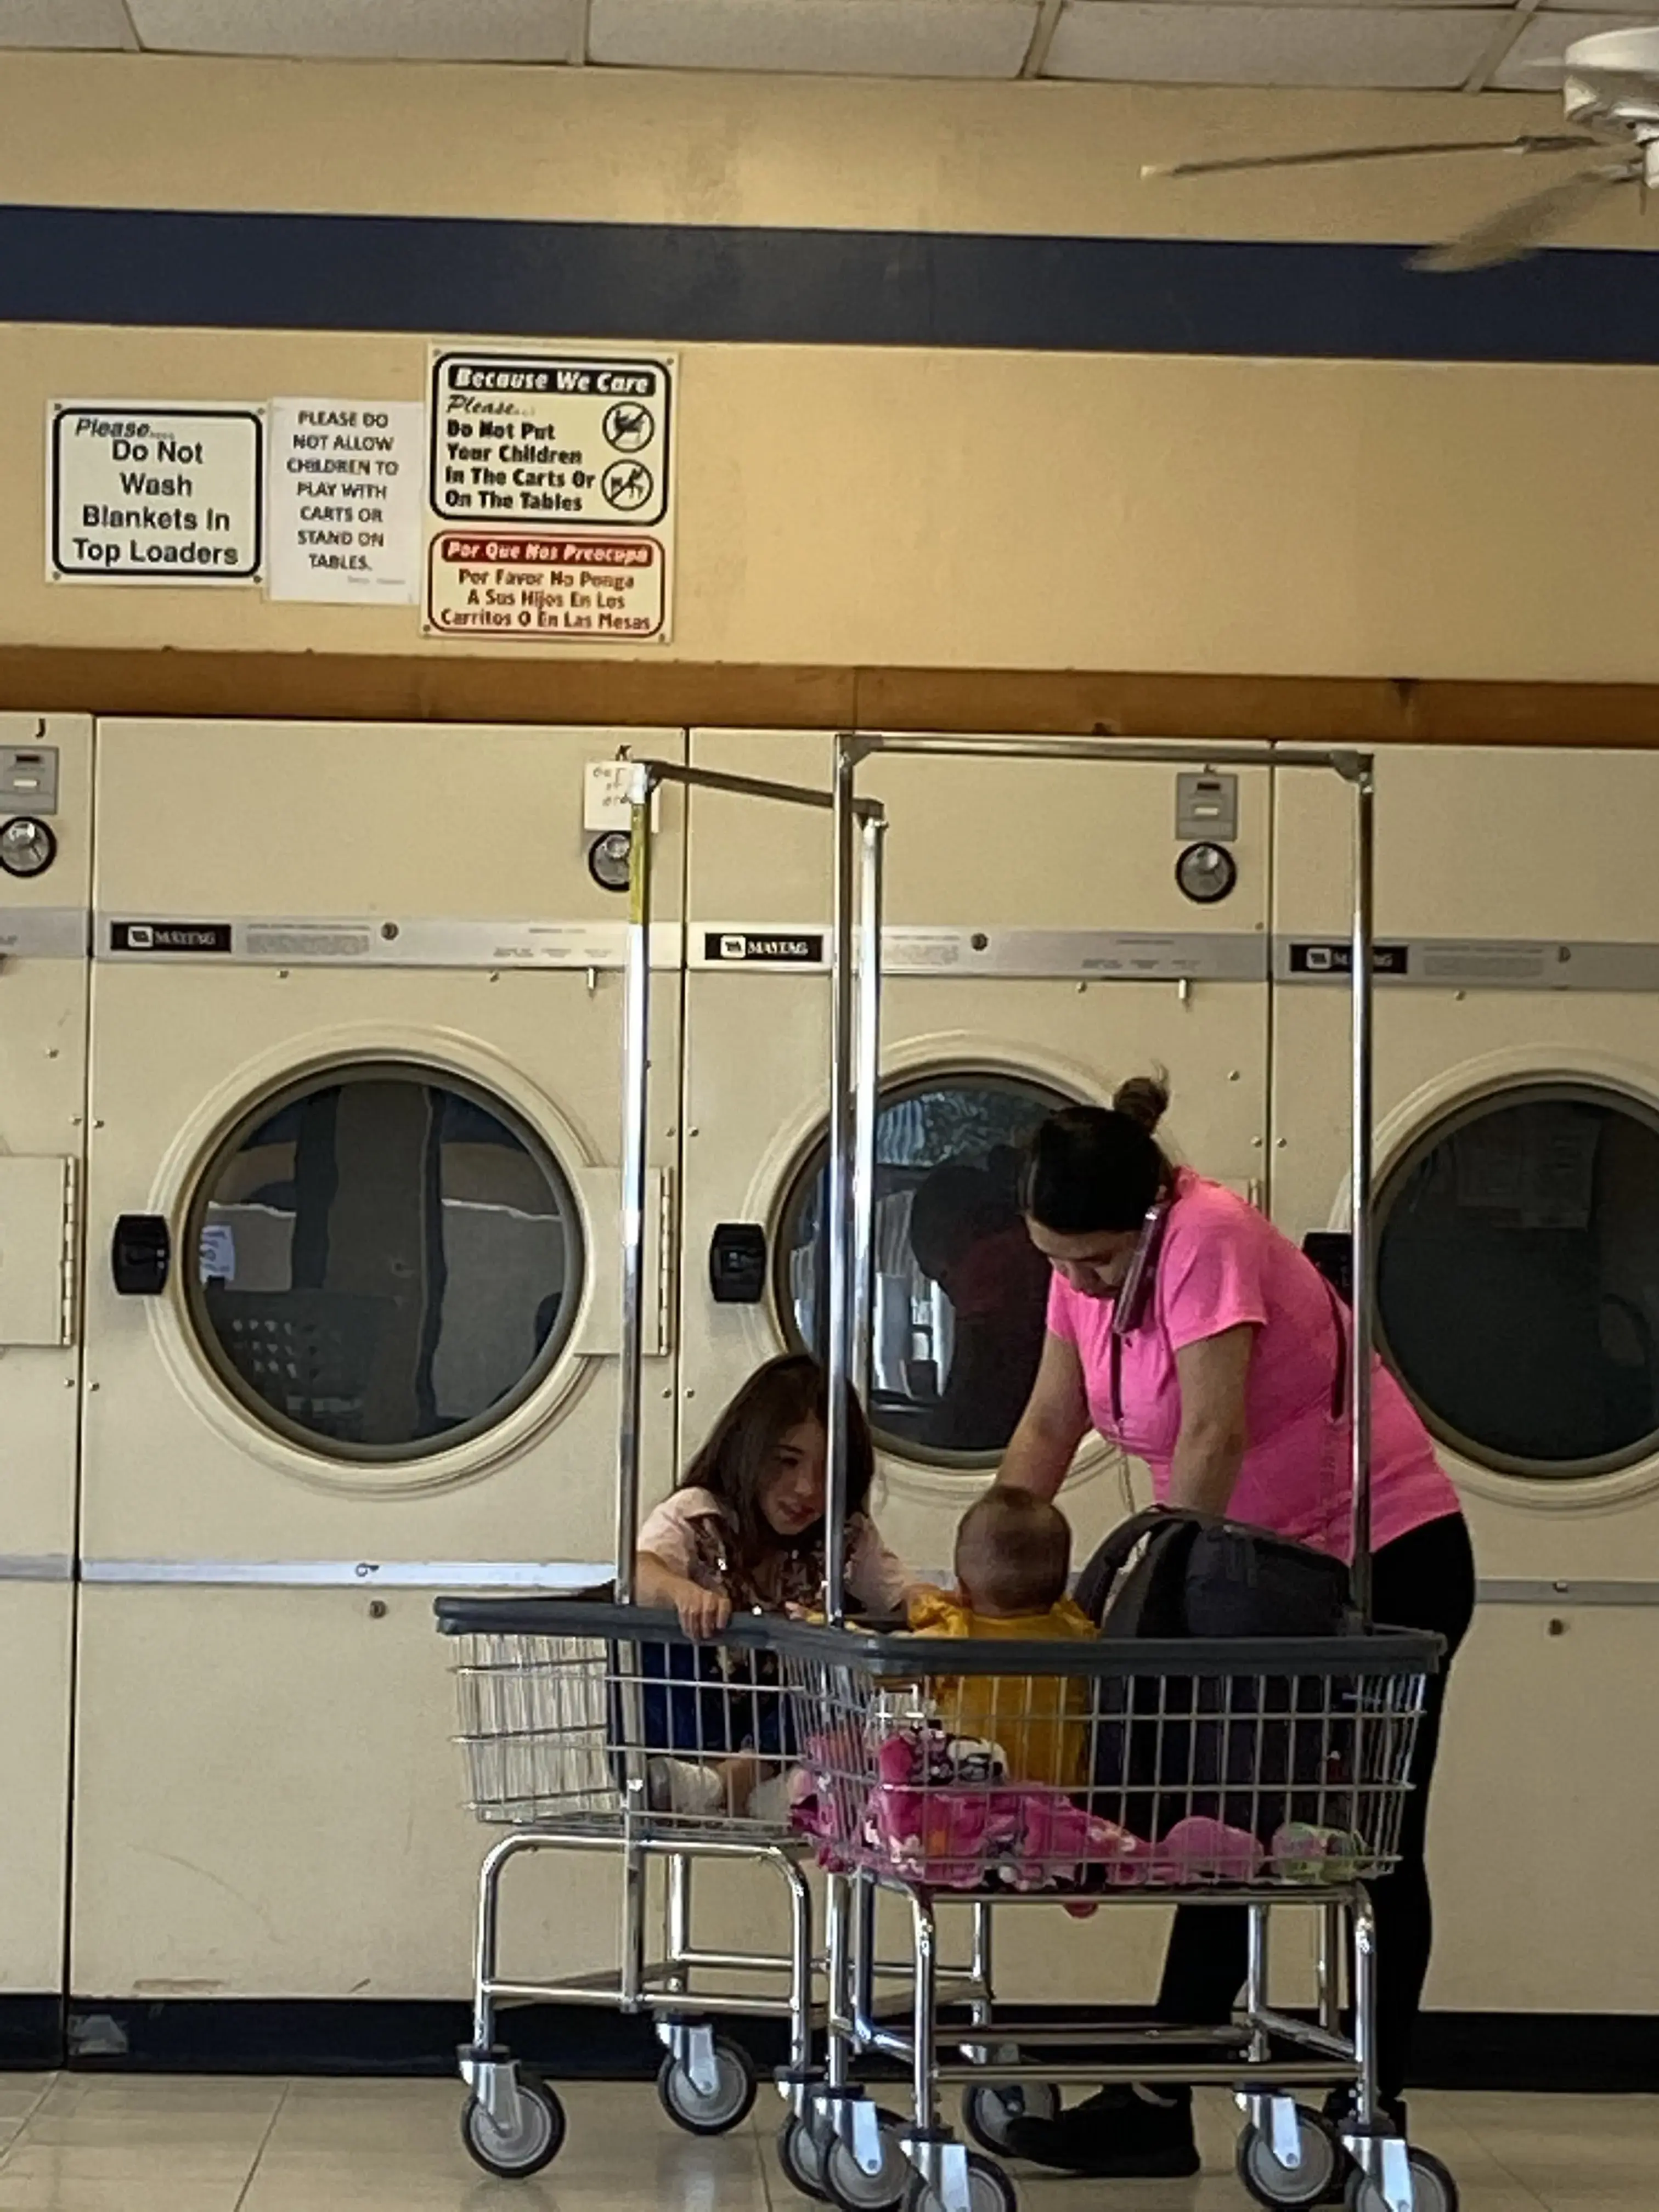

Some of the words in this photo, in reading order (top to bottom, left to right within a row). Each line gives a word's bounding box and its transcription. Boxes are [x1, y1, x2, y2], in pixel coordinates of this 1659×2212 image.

[455, 368, 549, 389] Because
[556, 371, 590, 391] We
[596, 373, 648, 393] Care
[297, 410, 358, 427] PLEASE
[363, 413, 389, 428] DO
[448, 419, 473, 437] Do
[479, 420, 514, 439] Not
[521, 422, 556, 440] Put
[112, 439, 149, 461] Do
[156, 441, 203, 464] Not
[292, 435, 329, 450] NOT
[333, 436, 394, 452] ALLOW
[447, 444, 492, 461] Your
[499, 446, 583, 464] Children
[286, 458, 371, 476] CHILDREN
[375, 461, 400, 476] TO
[445, 466, 464, 484] In
[471, 467, 506, 486] The
[512, 469, 565, 487] Carts
[572, 470, 596, 489] Or
[120, 472, 193, 497] Wash
[296, 482, 337, 498] PLAY
[342, 484, 388, 500] WITH
[445, 490, 471, 507] On
[478, 491, 514, 510] The
[520, 493, 583, 512] Tables
[82, 505, 198, 531] Blankets
[206, 508, 230, 531] In
[300, 506, 353, 522] CARTS
[358, 508, 384, 523] OR
[297, 530, 353, 546] STAND
[358, 532, 384, 547] ON
[72, 538, 120, 567] Top
[129, 540, 238, 565] Loaders
[447, 541, 479, 558] Por
[485, 543, 519, 560] Que
[525, 544, 558, 561] Nos
[563, 545, 648, 566] Preocupa
[459, 568, 489, 585] Por
[495, 569, 545, 586] Favor
[550, 571, 574, 587] No
[580, 571, 634, 591] Ponga
[467, 589, 479, 605] A
[486, 589, 515, 605] Sus
[521, 590, 564, 610] Hijos
[571, 591, 591, 607] En
[597, 592, 625, 609] Los
[441, 608, 511, 627] Carritos
[518, 610, 531, 626] O
[538, 608, 558, 628] En
[564, 611, 592, 628] Las
[599, 613, 650, 630] Mesas
